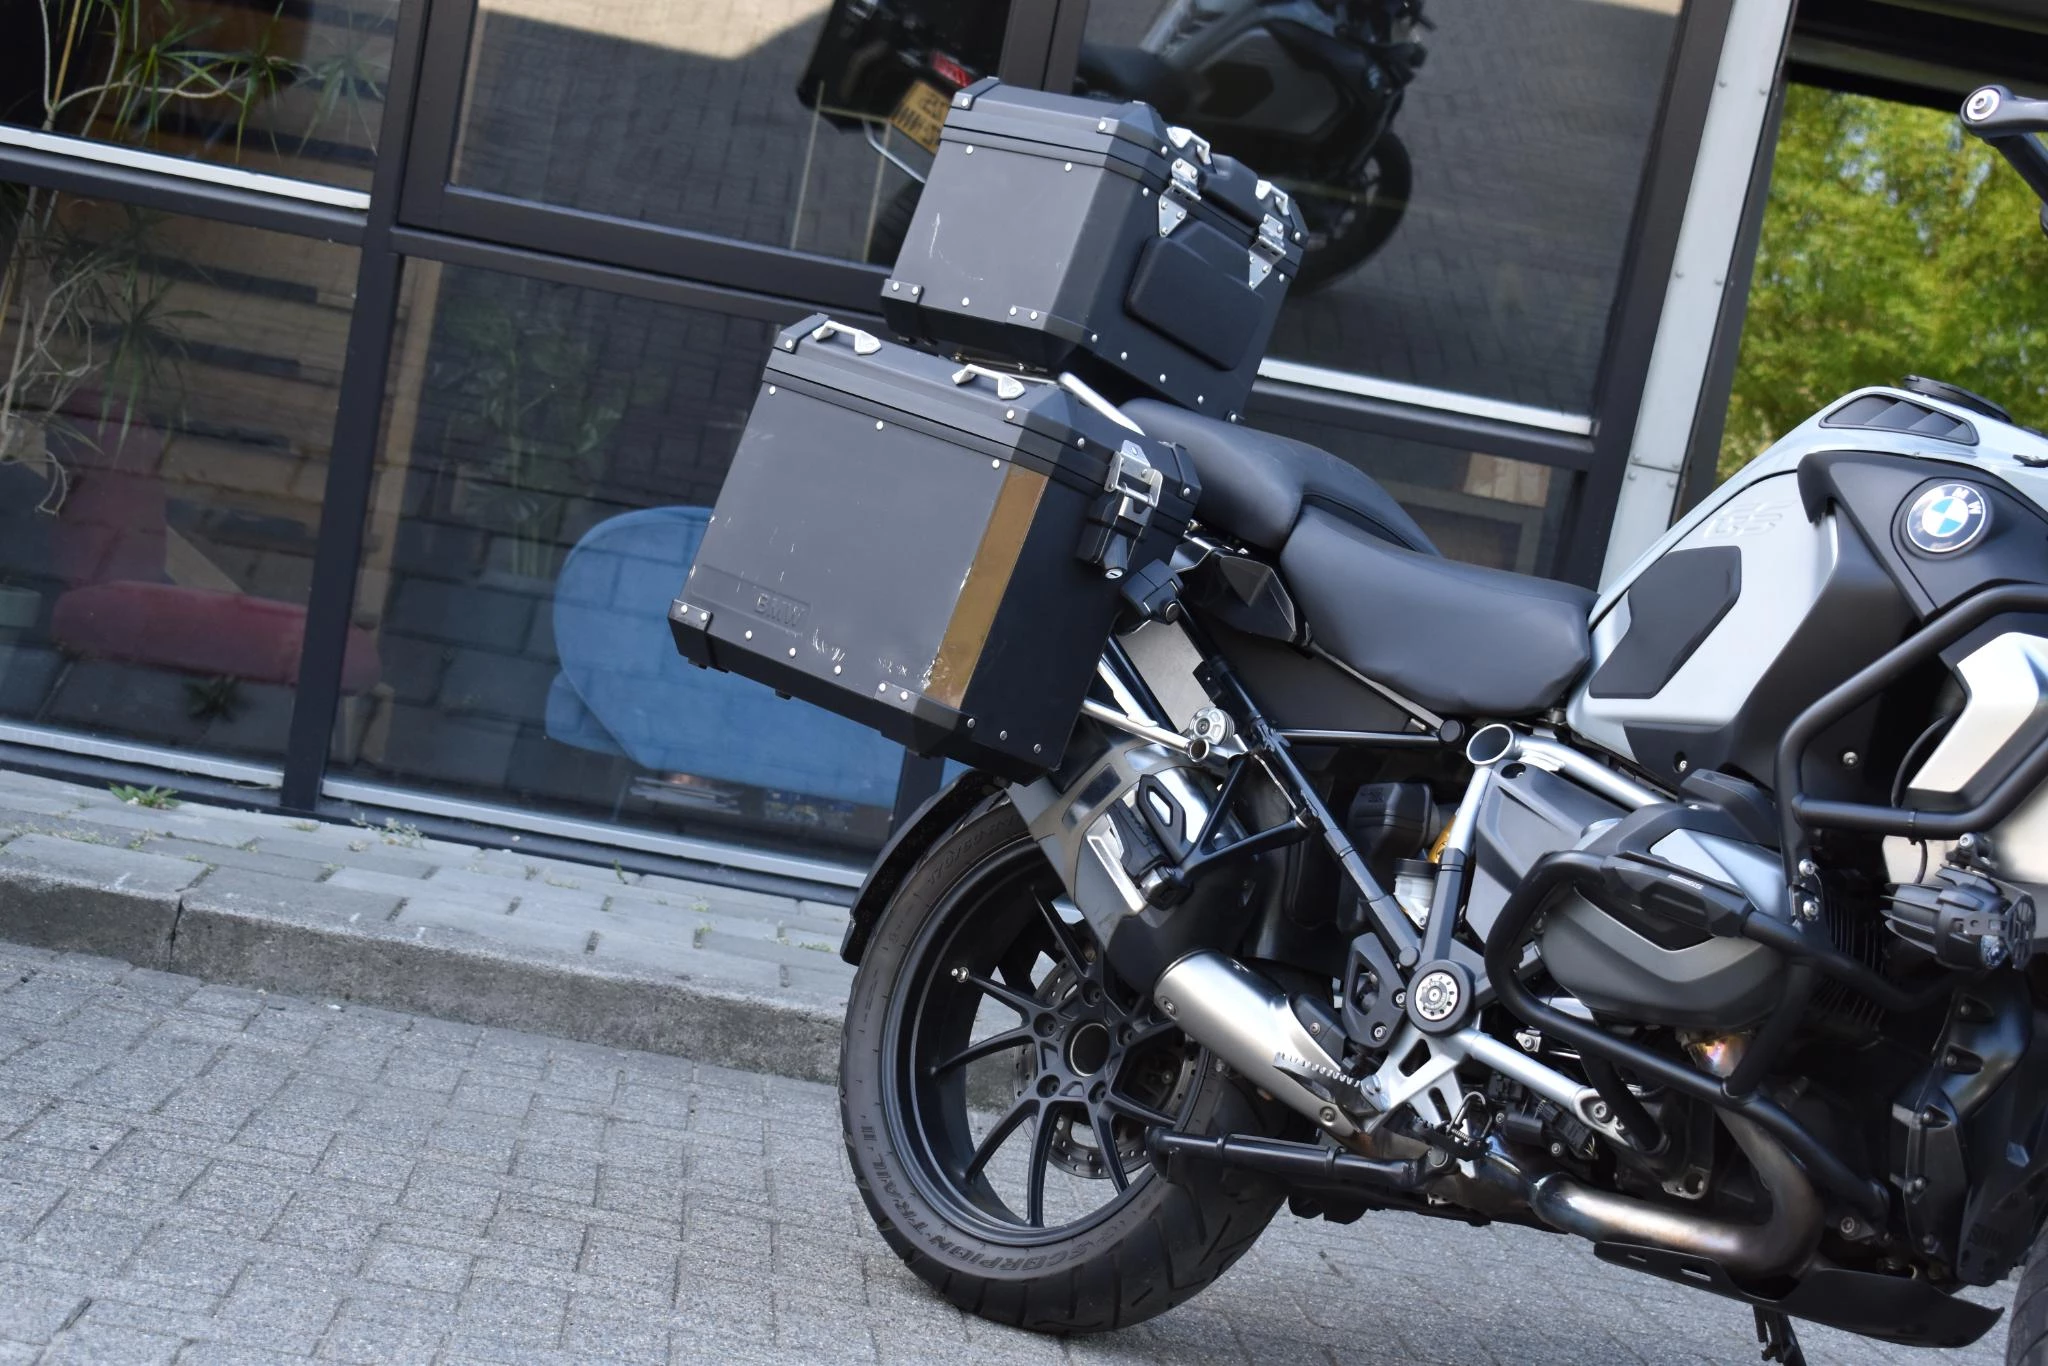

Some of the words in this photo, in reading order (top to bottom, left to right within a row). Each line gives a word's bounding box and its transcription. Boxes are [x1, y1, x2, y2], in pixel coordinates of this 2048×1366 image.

[755, 592, 805, 627] BMW
[872, 1153, 928, 1235] TRAIL
[929, 1235, 1096, 1271] SCORPION
